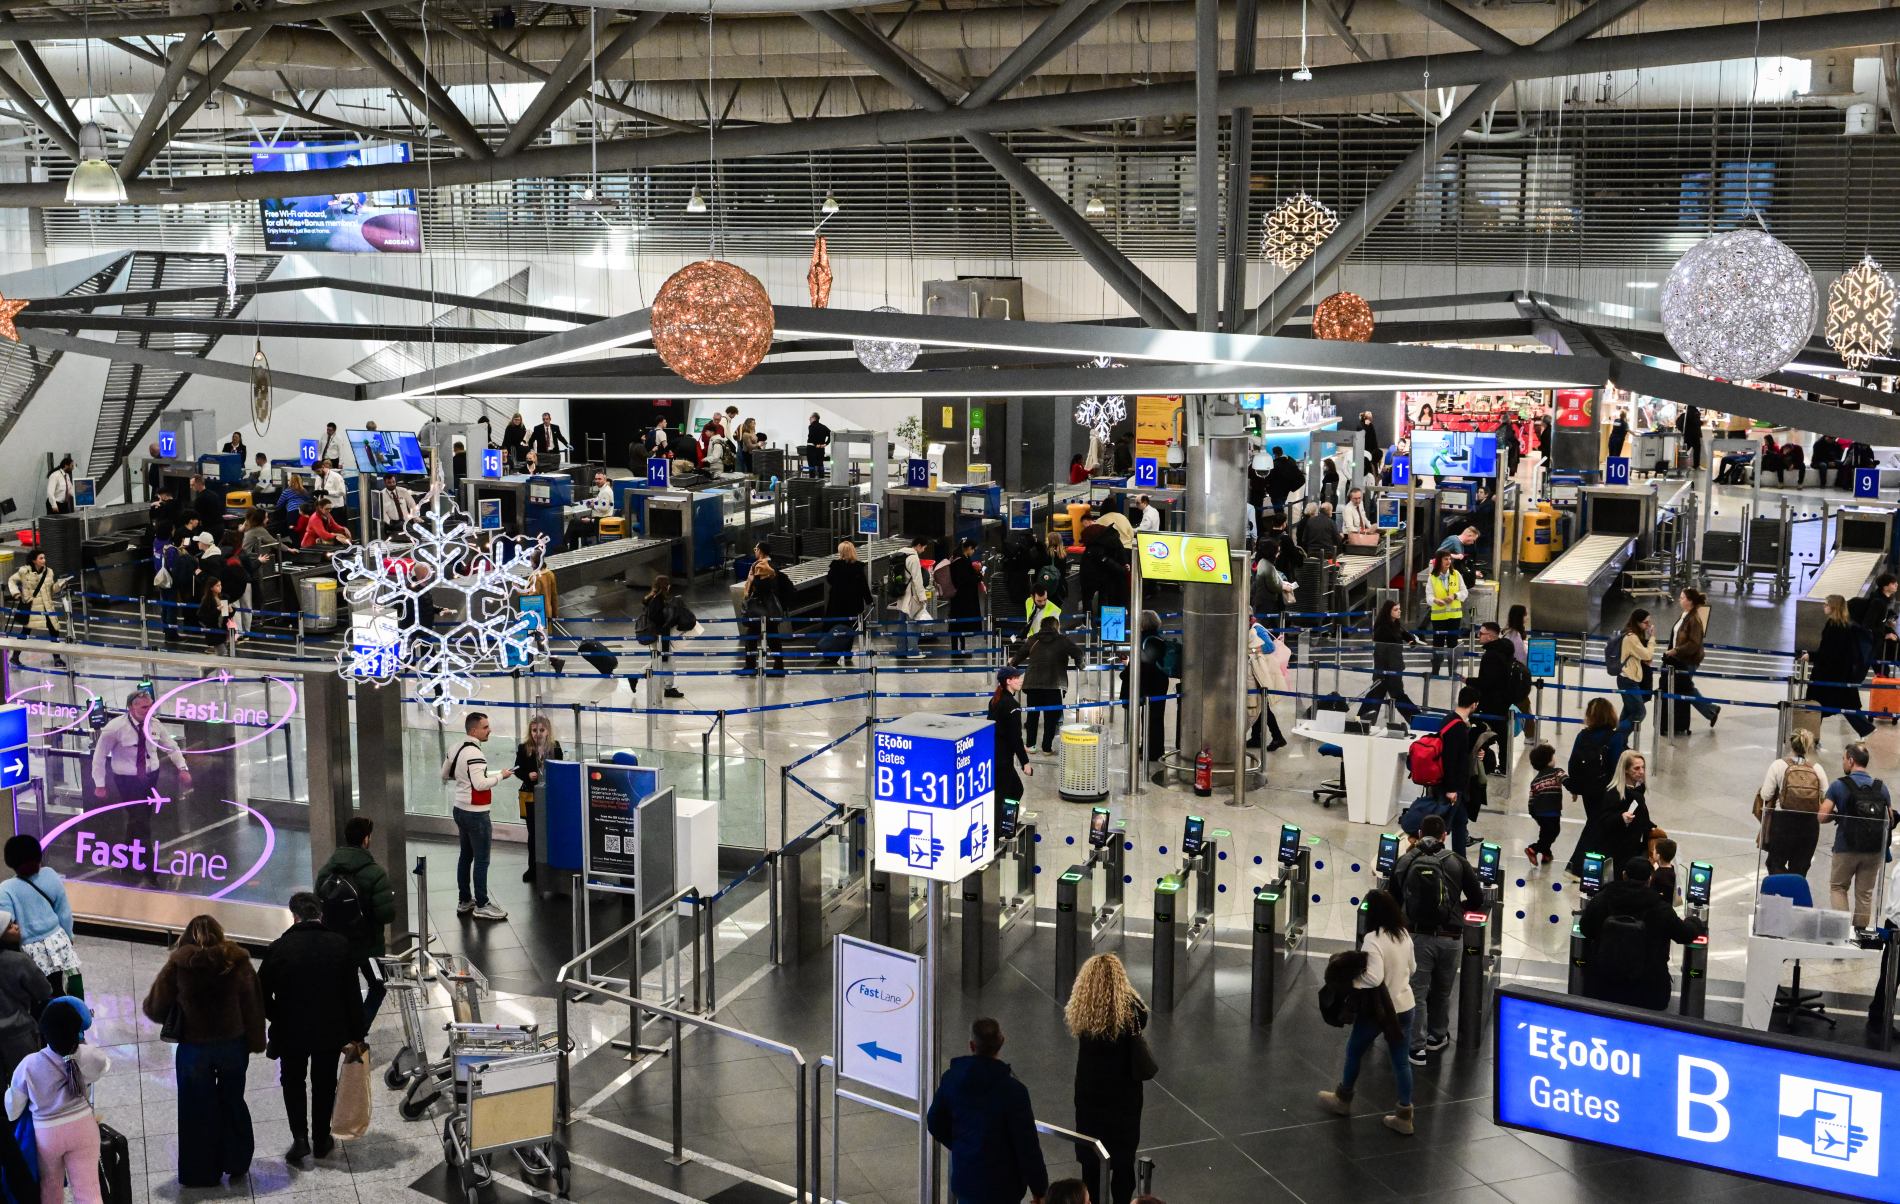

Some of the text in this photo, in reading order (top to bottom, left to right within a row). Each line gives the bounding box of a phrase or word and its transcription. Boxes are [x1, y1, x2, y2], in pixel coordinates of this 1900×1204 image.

[297, 210, 327, 219] onboard,
[284, 219, 325, 227] Miles+Bonus
[161, 437, 174, 451] 17
[302, 445, 316, 460] 16
[484, 455, 498, 470] 15
[1609, 463, 1625, 478] 10
[650, 466, 665, 480] 14
[911, 466, 926, 481] 13
[1138, 464, 1154, 480] 12
[1862, 476, 1872, 490] 9
[47, 702, 77, 718] Lane
[175, 697, 268, 726] Fast Lane
[875, 734, 912, 750] Έξοδοι
[955, 736, 974, 754] Έξοδοι
[878, 750, 905, 765] Gates
[956, 755, 970, 770] Gates
[878, 766, 948, 805] B 1-31
[956, 758, 992, 804] B 1-31
[76, 831, 228, 881] Fast Lane
[860, 984, 901, 1005] Fast Lane
[1517, 1022, 1641, 1078] Έξοδοι
[1529, 1075, 1620, 1124] Gates
[1677, 1054, 1731, 1143] B
